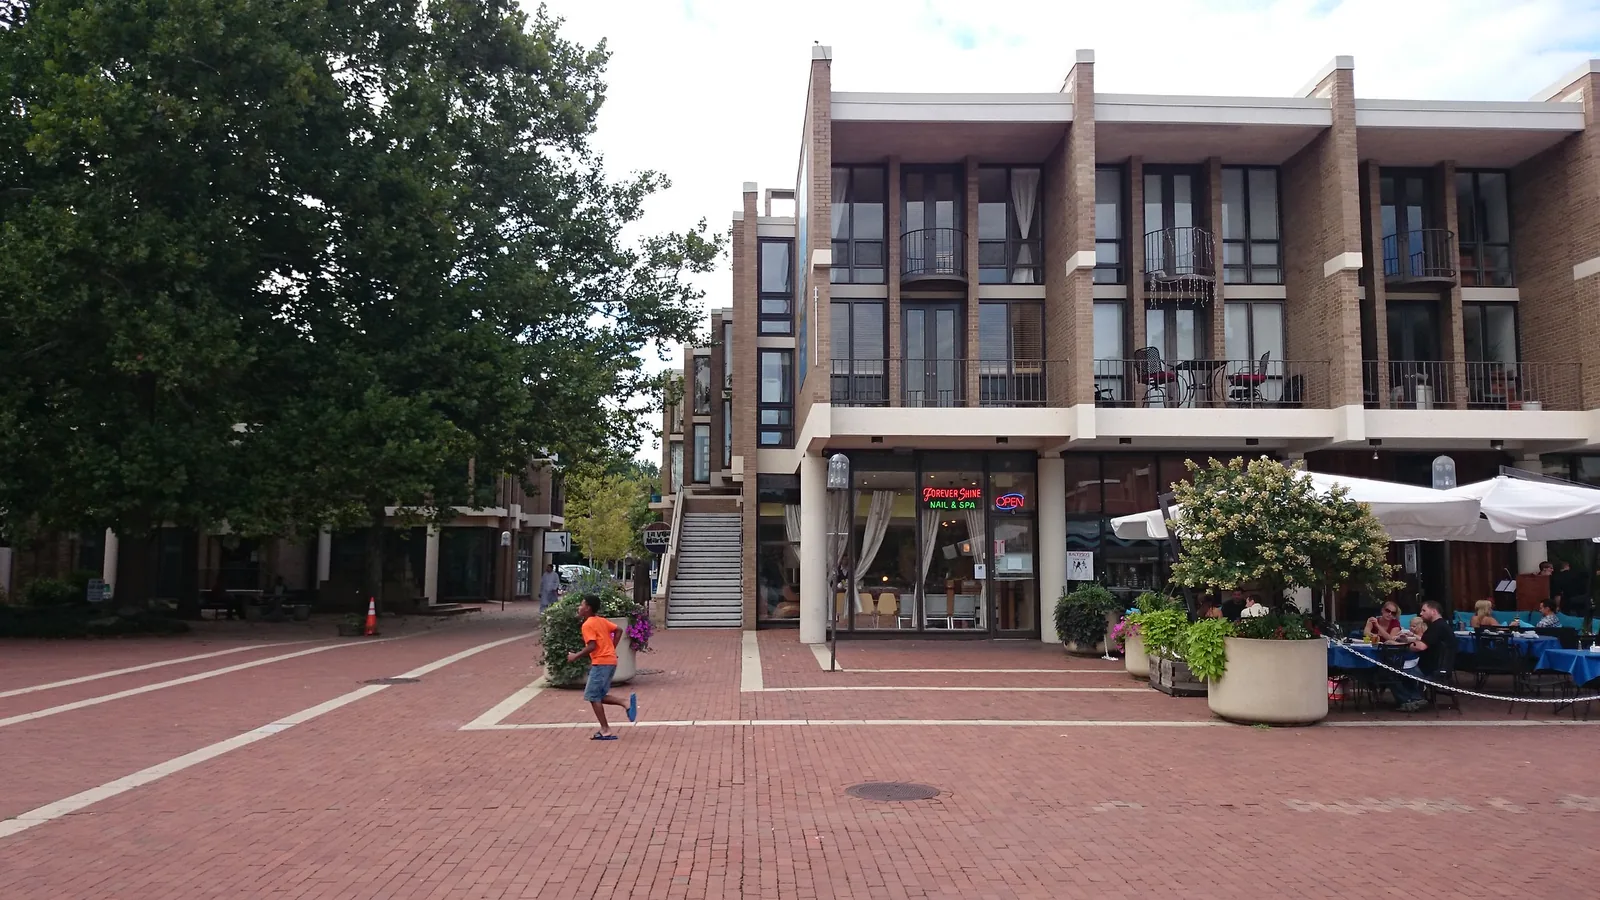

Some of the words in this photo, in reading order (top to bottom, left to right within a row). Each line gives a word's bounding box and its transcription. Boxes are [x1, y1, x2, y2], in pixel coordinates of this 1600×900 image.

[930, 501, 948, 509] NAIL
[951, 501, 957, 509] &
[959, 501, 976, 509] SPA
[996, 496, 1024, 507] OPEN
